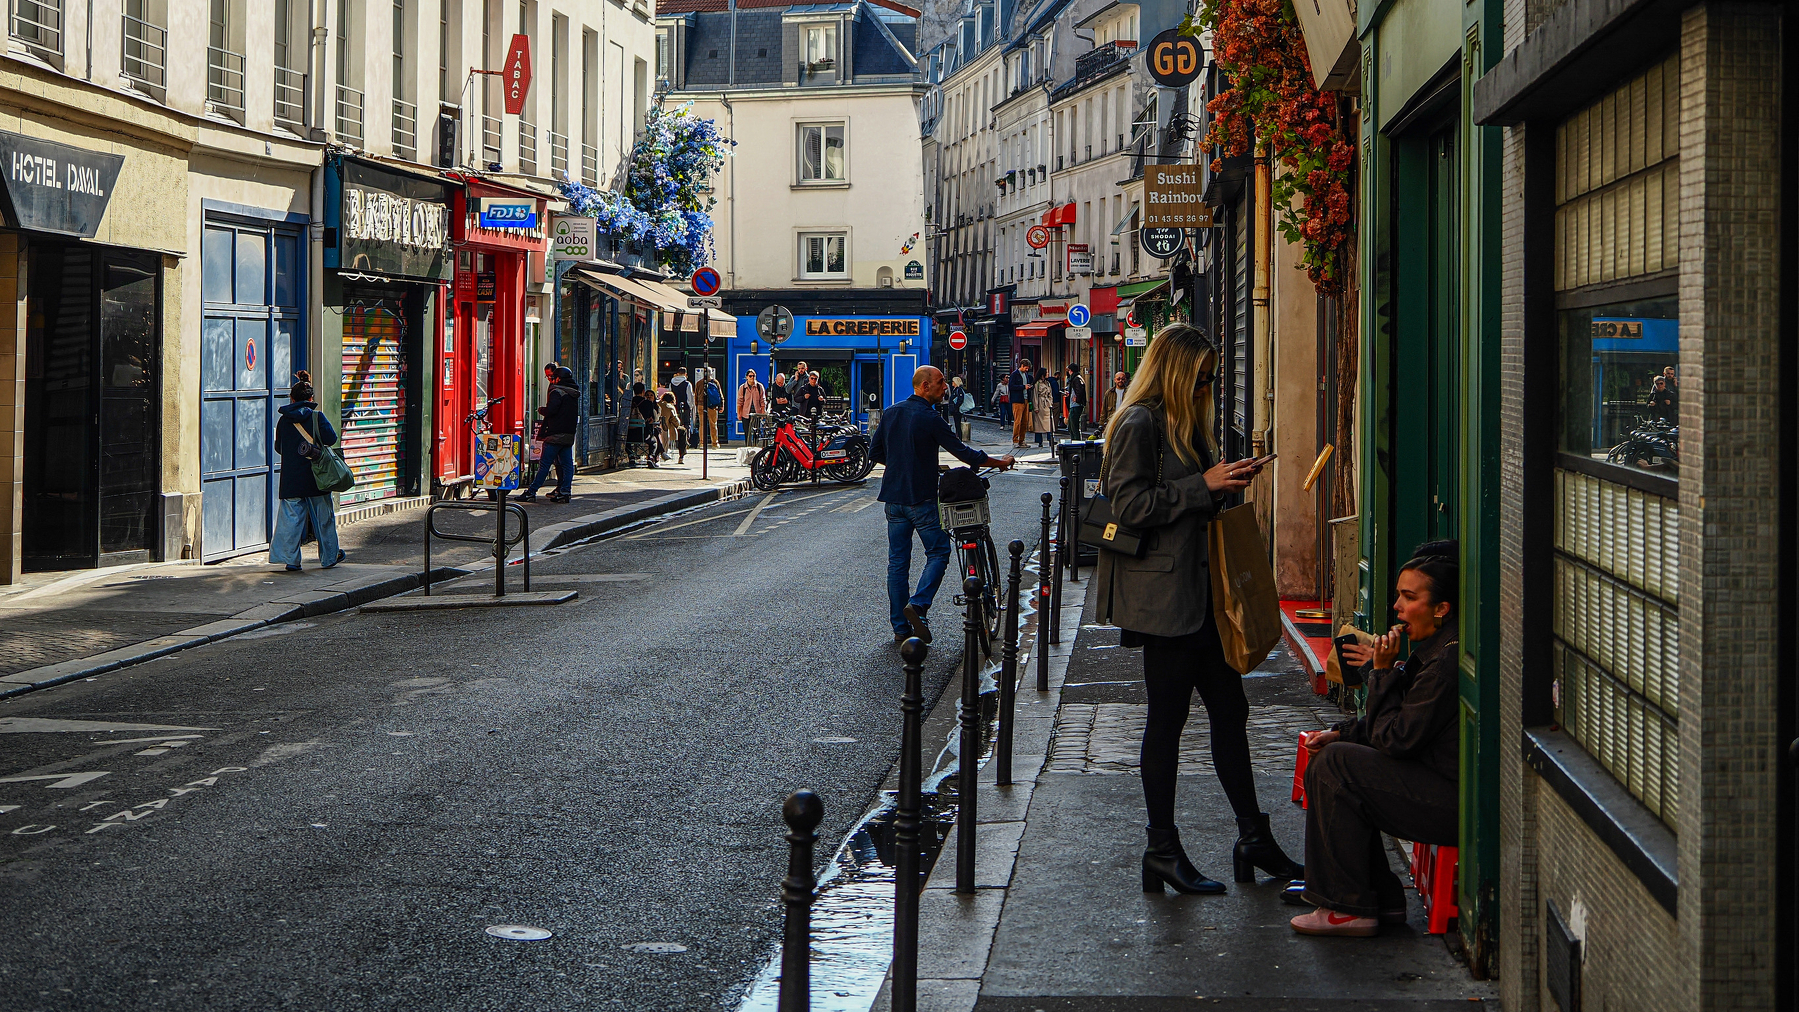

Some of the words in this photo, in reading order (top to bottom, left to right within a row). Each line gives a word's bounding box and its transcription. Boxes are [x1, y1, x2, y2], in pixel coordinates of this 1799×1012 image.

[511, 50, 523, 99] TABAC
[12, 151, 62, 189] HOTEL
[67, 163, 104, 197] DAVAL
[1157, 172, 1197, 185] Sushi
[489, 207, 514, 219] FDJ
[1149, 215, 1159, 223] 01
[1161, 215, 1172, 223] 43
[1174, 215, 1184, 223] 55
[1186, 215, 1197, 223] 26
[1199, 215, 1209, 223] 97
[556, 233, 588, 245] aoba
[807, 320, 831, 335] LA
[833, 320, 918, 335] CREPERIE
